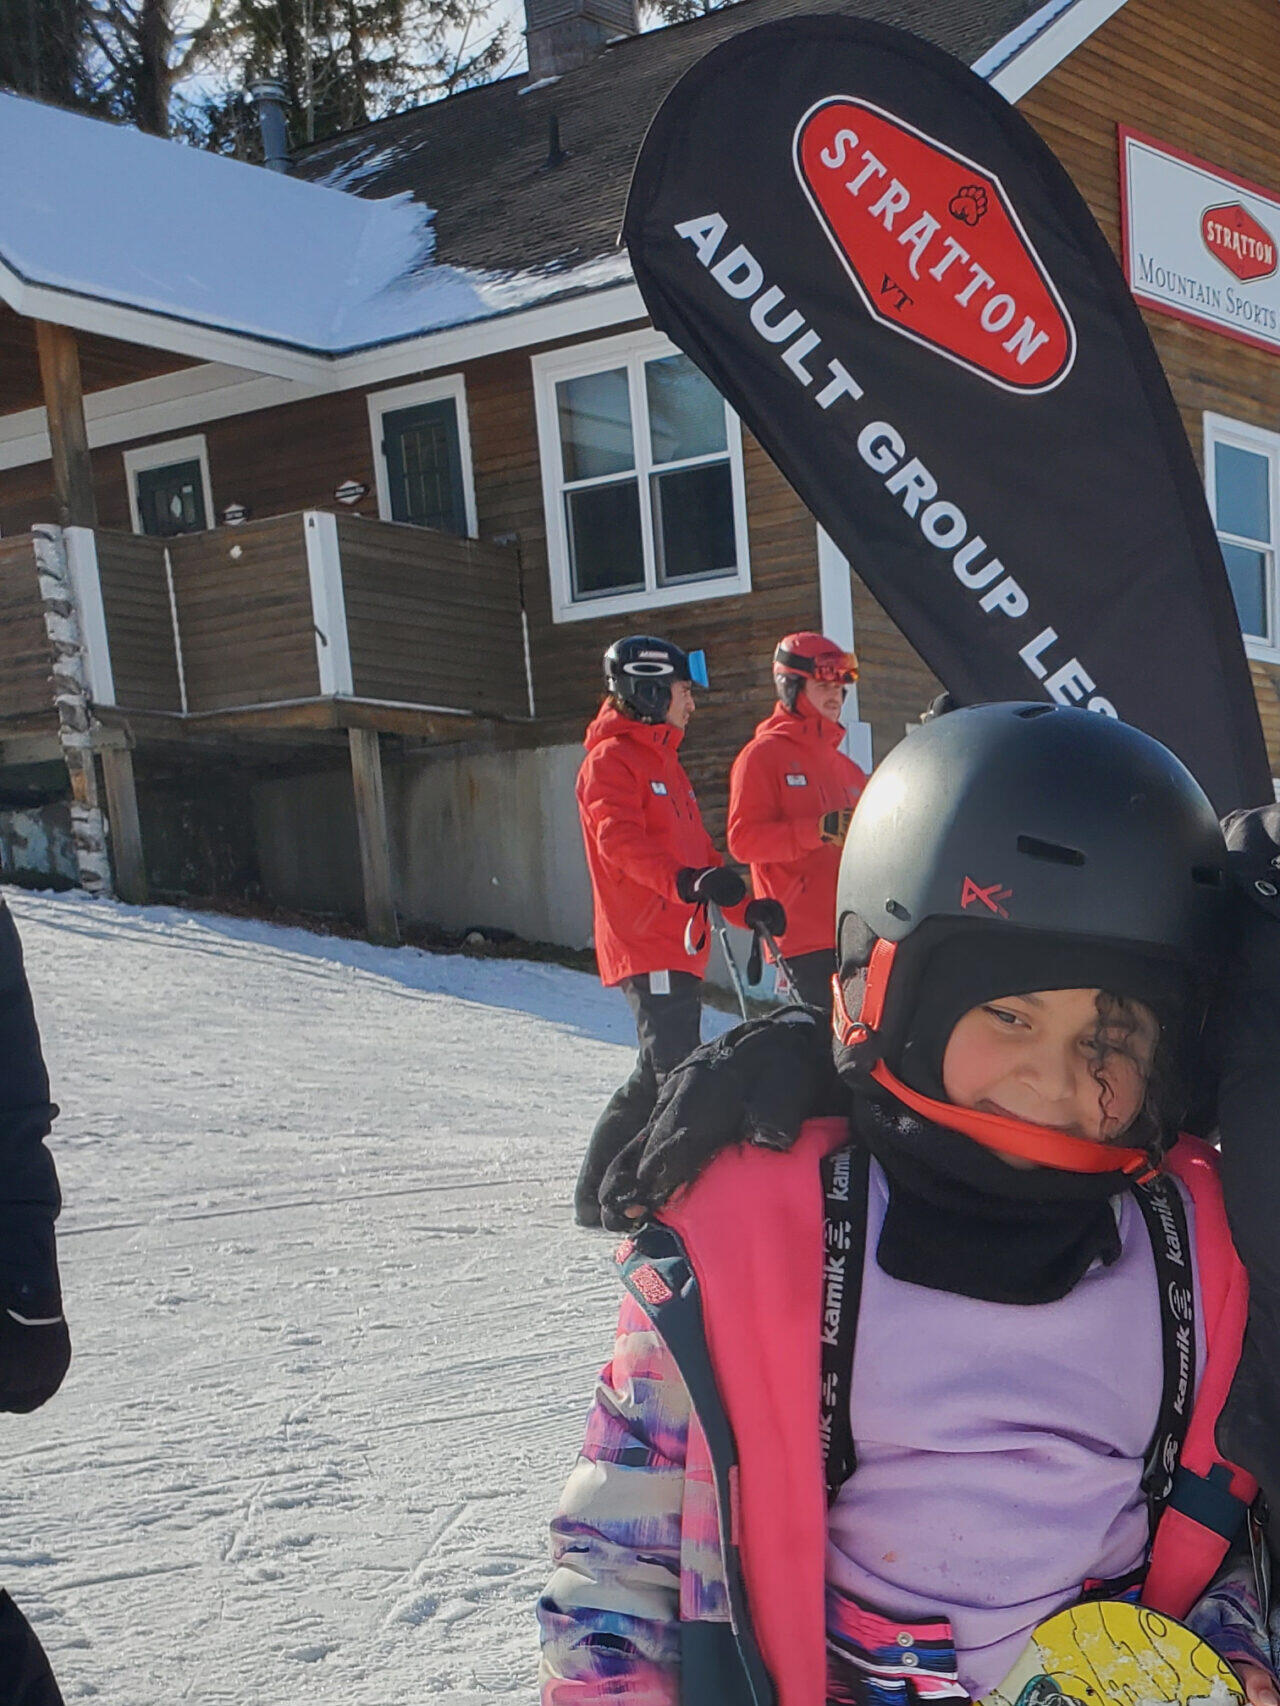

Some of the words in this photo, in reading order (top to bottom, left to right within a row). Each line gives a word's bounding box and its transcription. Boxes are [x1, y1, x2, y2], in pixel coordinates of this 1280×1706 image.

[820, 129, 1050, 365] STRATTON
[1206, 220, 1273, 266] STRATTON
[877, 273, 914, 313] VT
[674, 212, 864, 410] ADULT
[855, 420, 1030, 620] GROUP
[1149, 1194, 1185, 1267] kamik
[820, 1254, 847, 1346] kamik
[1173, 1323, 1191, 1415] kamik
